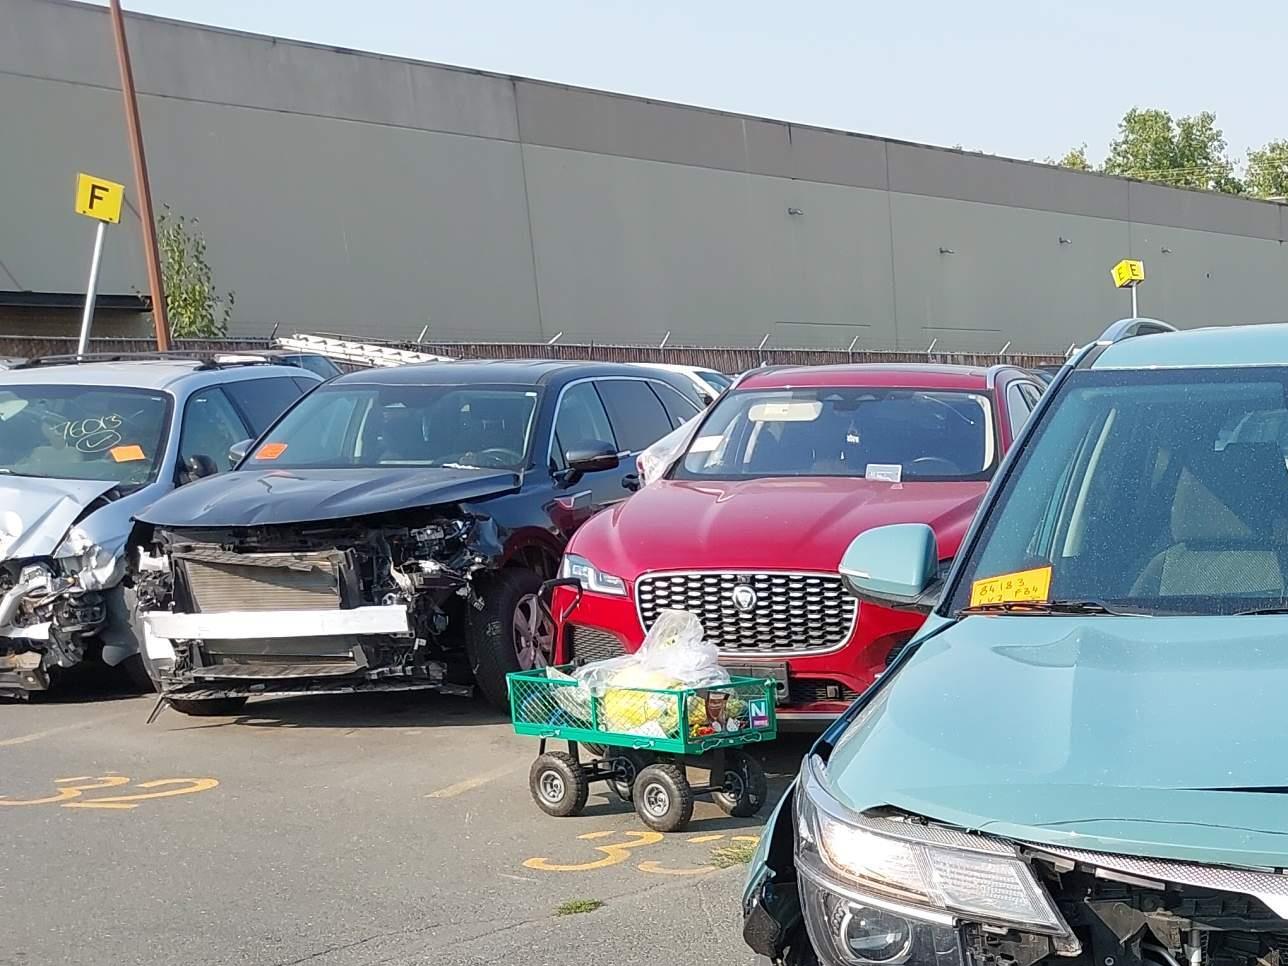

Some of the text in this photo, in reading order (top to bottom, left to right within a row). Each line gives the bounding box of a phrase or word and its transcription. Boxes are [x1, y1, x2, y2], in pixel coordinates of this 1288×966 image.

[89, 183, 110, 210] F
[1129, 263, 1139, 277] E
[751, 701, 766, 717] N
